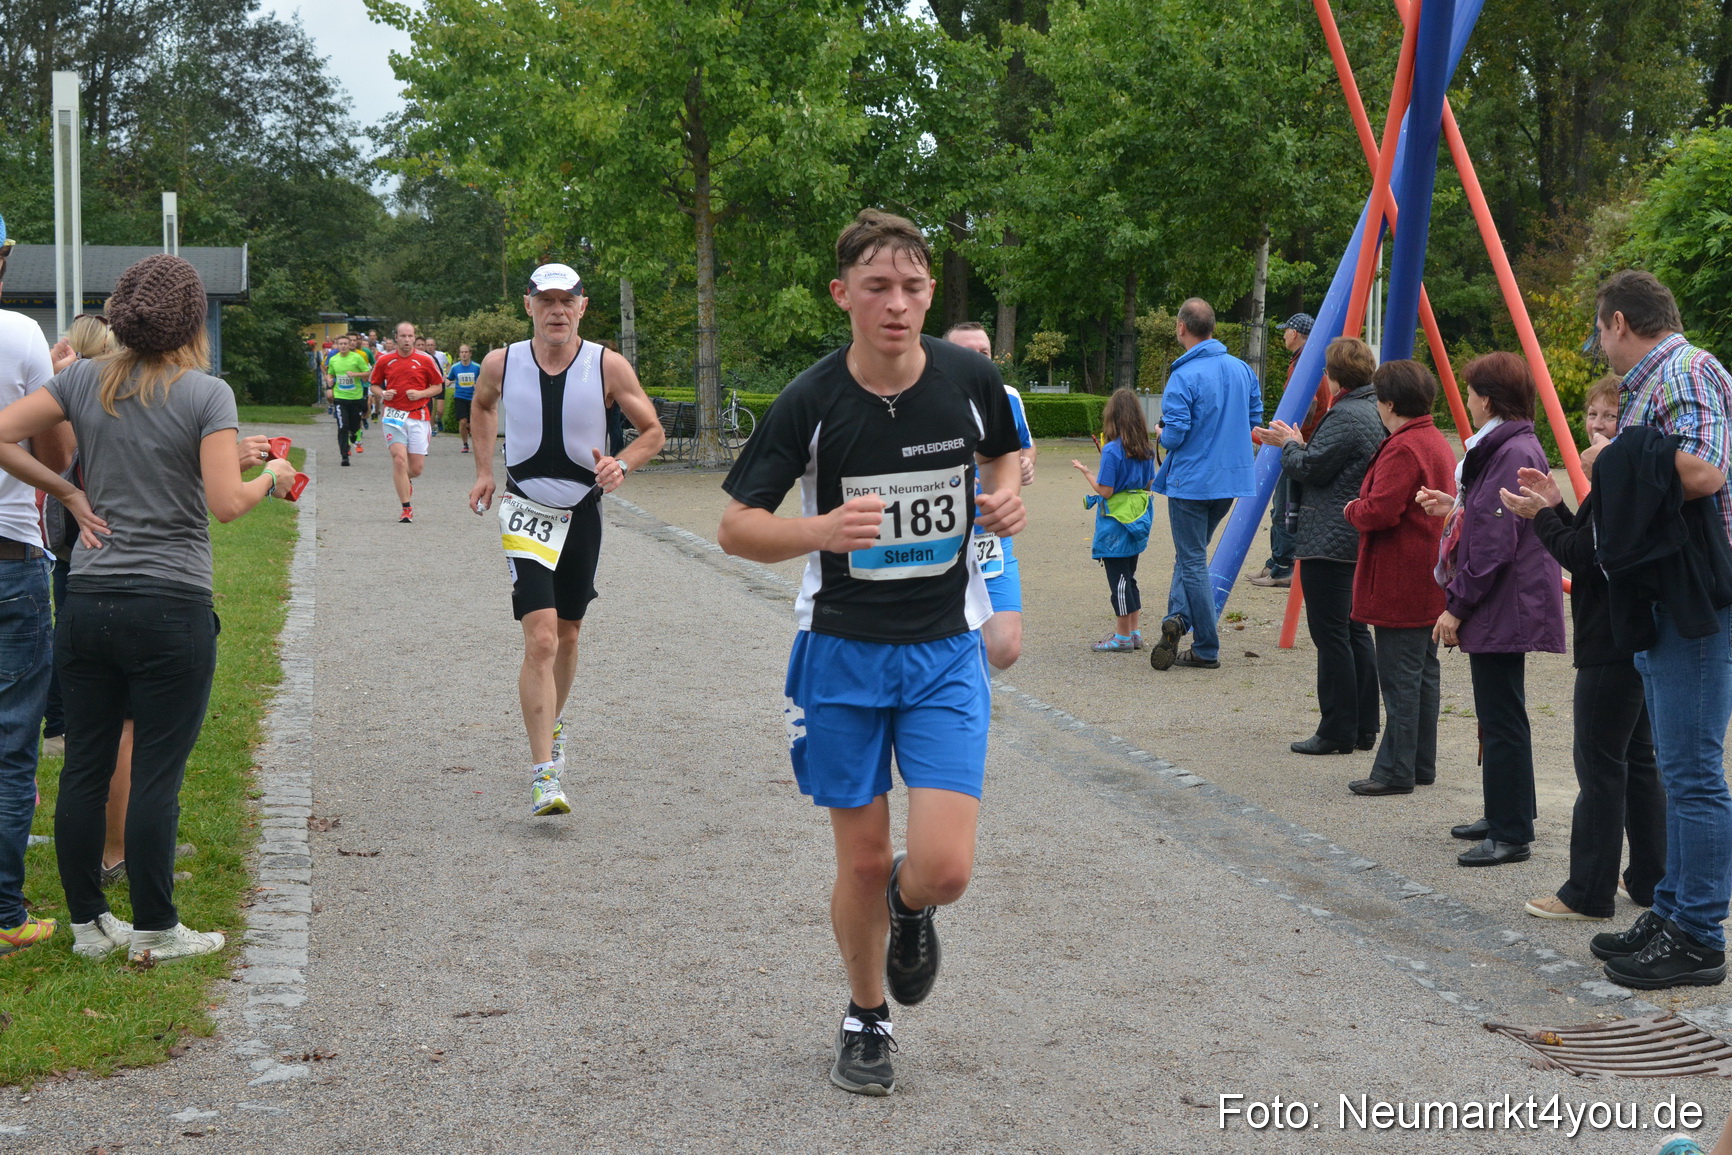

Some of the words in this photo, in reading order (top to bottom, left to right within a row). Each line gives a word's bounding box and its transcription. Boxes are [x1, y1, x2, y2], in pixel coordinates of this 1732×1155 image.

[912, 437, 966, 456] PFLEIDERER
[846, 486, 887, 497] PARTL
[889, 481, 946, 495] Neumarkt
[503, 498, 525, 511] PARTL
[525, 506, 559, 521] Neumarkt
[873, 494, 957, 540] 183
[508, 511, 553, 543] 643
[884, 548, 935, 564] Stefan
[974, 540, 997, 561] 32
